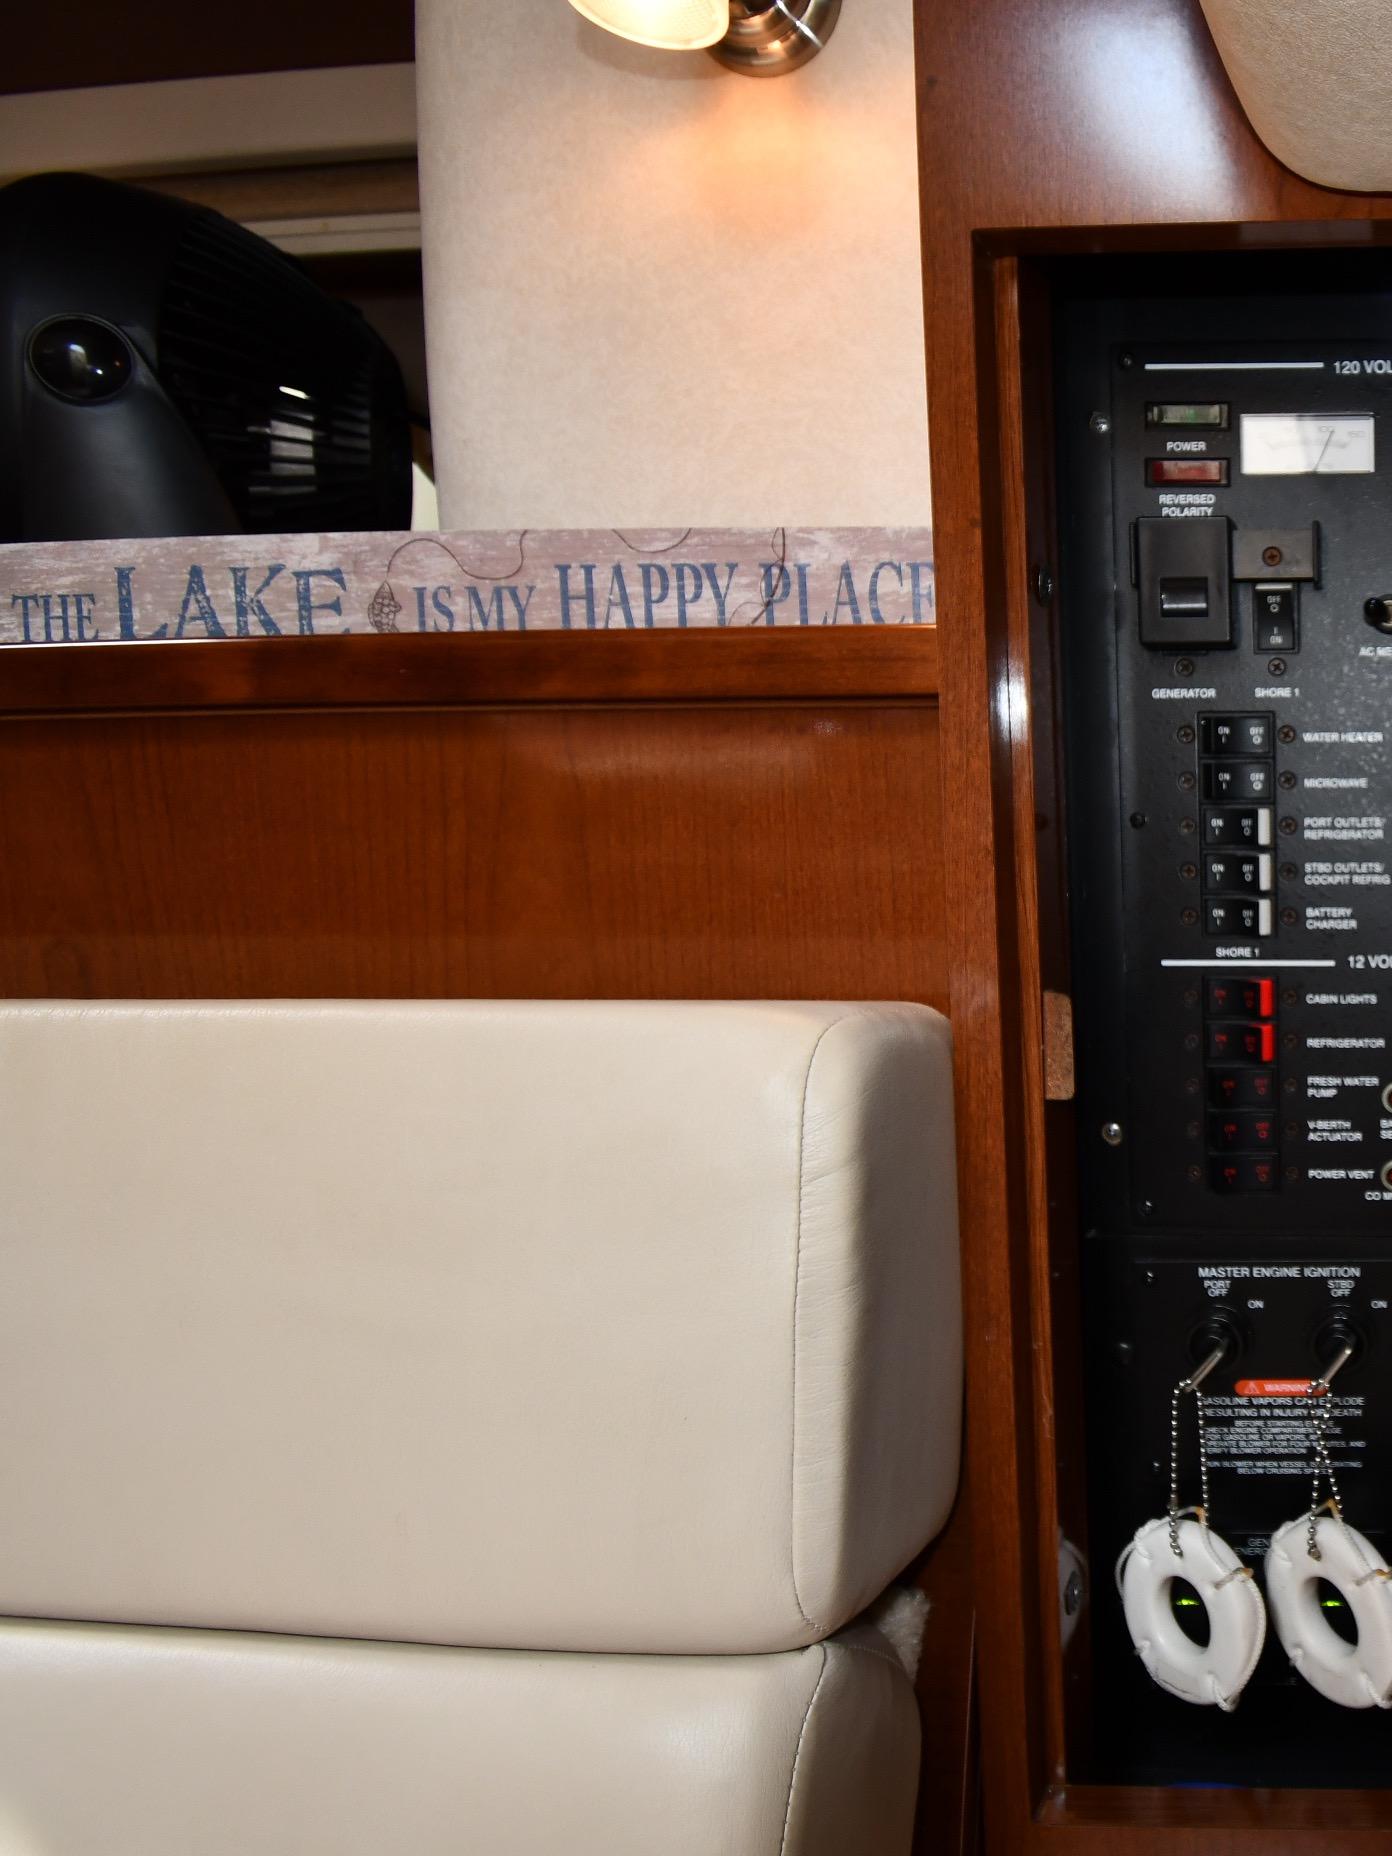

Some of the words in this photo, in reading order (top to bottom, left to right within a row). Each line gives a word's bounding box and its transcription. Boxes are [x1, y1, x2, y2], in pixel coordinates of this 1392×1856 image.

[1334, 360, 1360, 374] 120
[1167, 441, 1206, 451] POWER
[1159, 494, 1216, 505] REVERSED
[1162, 506, 1213, 517] POLARITY
[11, 593, 98, 642] THE
[113, 564, 351, 639] LAKE
[412, 585, 455, 633] IS
[465, 585, 536, 633] MY
[554, 562, 738, 630] HAPPY
[1266, 595, 1281, 603] OFF
[1269, 635, 1283, 644] ON
[1359, 647, 1374, 657] AC
[1152, 688, 1216, 699] GENERATOR
[1254, 687, 1292, 698] SHORE
[1294, 688, 1300, 698] 1
[1217, 726, 1230, 734] ON
[1249, 726, 1264, 735] OFF
[1302, 732, 1339, 743] WATER
[1341, 732, 1384, 743] HEATER
[1218, 773, 1231, 781] ON
[1250, 772, 1265, 781] OFF
[1303, 777, 1369, 788] MICROWAVE
[1210, 818, 1224, 827] ON
[1303, 817, 1332, 828] PORT
[1303, 829, 1384, 840] REFRIGERATOR
[1211, 864, 1225, 873] ON
[1304, 862, 1332, 873] STBD
[1304, 874, 1351, 885] COCKPIT
[1352, 874, 1392, 885] REFRIG
[1212, 909, 1225, 918] ON
[1306, 907, 1352, 918] BATTERY
[1306, 919, 1358, 930] CHARGER
[1215, 947, 1251, 957] SHORE
[1254, 947, 1260, 957] 1
[1347, 955, 1366, 969] 12
[1306, 994, 1338, 1004] CABIN
[1340, 994, 1378, 1004] LIGHTS
[1306, 1037, 1386, 1048] REFRIGERATOR
[1307, 1077, 1342, 1087] FRESH
[1343, 1077, 1380, 1087] WATER
[1307, 1088, 1338, 1099] PUMP
[1307, 1120, 1352, 1130] V-BERTH
[1307, 1132, 1363, 1143] ACTUATOR
[1308, 1170, 1347, 1180] POWER
[1348, 1170, 1375, 1180] VENT
[1365, 1191, 1382, 1201] CO
[1198, 1267, 1250, 1278] MASTER
[1252, 1267, 1301, 1278] ENGINE
[1304, 1267, 1361, 1278] IGNITION
[1204, 1280, 1231, 1289] PORT
[1327, 1280, 1355, 1289] STBD
[1207, 1289, 1228, 1297] OFF
[1330, 1289, 1351, 1297] OFF
[1247, 1300, 1264, 1309] ON
[1370, 1300, 1388, 1309] ON
[1251, 1397, 1293, 1406] VAPORS
[1204, 1408, 1258, 1417] RESULTING
[1260, 1408, 1271, 1417] IN
[1273, 1408, 1309, 1417] INJURY
[1330, 1408, 1362, 1417] DEATH
